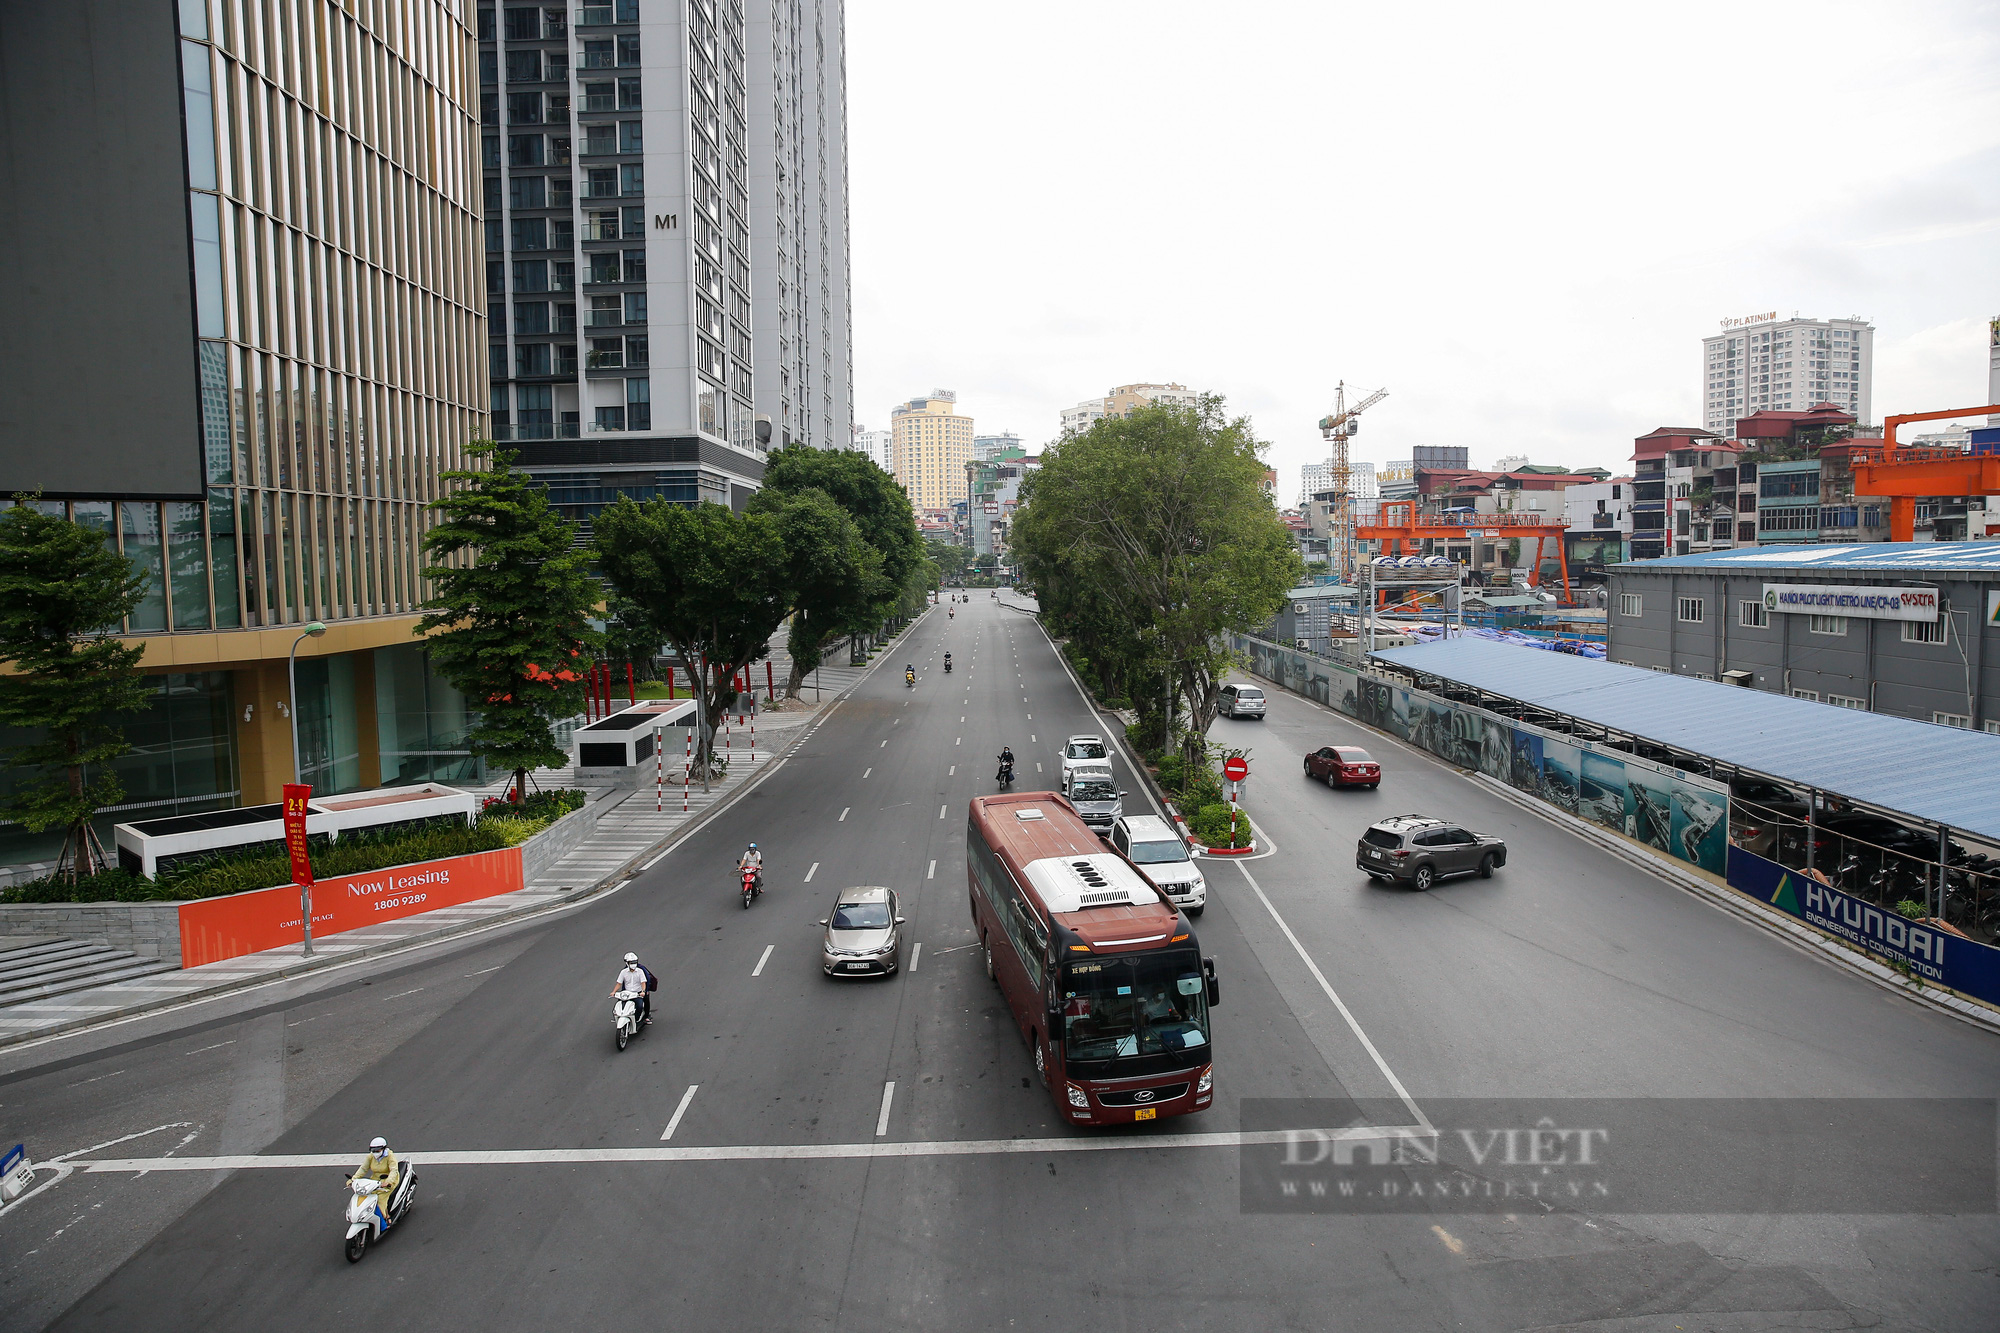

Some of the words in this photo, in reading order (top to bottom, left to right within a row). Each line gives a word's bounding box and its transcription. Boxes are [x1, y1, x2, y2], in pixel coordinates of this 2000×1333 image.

[655, 214, 677, 229] M1
[1734, 311, 1776, 327] PLATINUM
[1376, 470, 1395, 482] NAM
[1779, 592, 1799, 604] HANOI
[1799, 593, 1816, 605] PILOT
[1816, 594, 1834, 606] LIGHT
[1835, 595, 1859, 607] METRO
[1900, 593, 1936, 607] SYSTRA
[348, 881, 384, 897] Now
[389, 870, 450, 890] Leasing
[374, 898, 399, 911] 1800
[402, 893, 427, 905] 9289
[312, 913, 334, 922] PLACE
[1806, 883, 1944, 965] HYUNDAI
[1806, 911, 1858, 941] ENGINEERING
[1860, 936, 1867, 945] &
[1869, 940, 1942, 980] CONSTRUCTION
